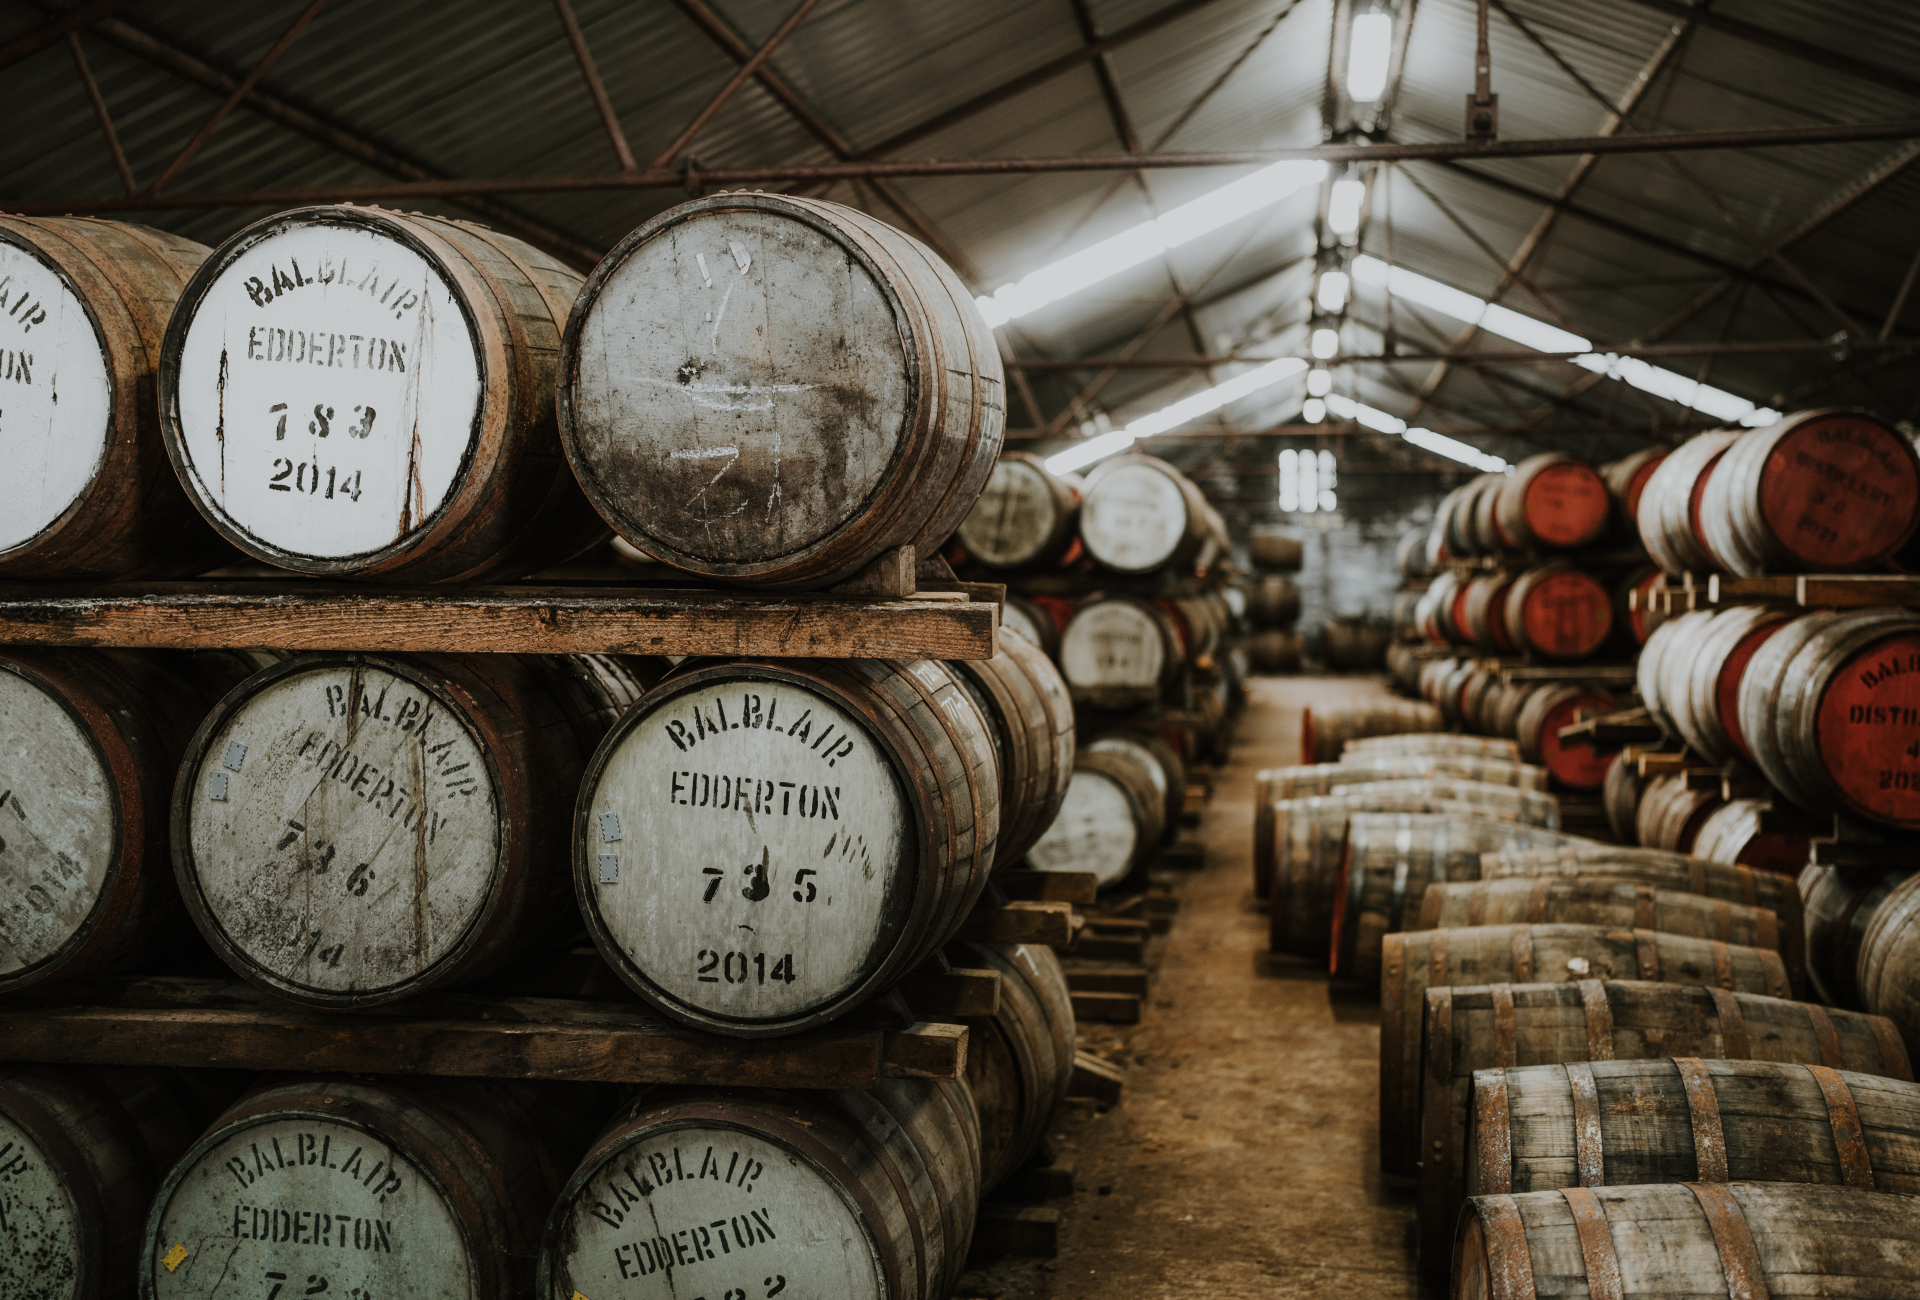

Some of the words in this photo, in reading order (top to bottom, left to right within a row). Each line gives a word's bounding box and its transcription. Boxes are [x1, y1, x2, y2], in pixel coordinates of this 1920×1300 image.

[243, 255, 418, 320] BALBLAIR
[248, 325, 406, 373] EDDERTON
[268, 457, 362, 502] 2014
[326, 684, 478, 799] BALBLAIR
[665, 694, 854, 767] BALBLAIR
[299, 730, 447, 845] EDDERTON
[670, 771, 840, 820] EDDERTON
[6, 851, 83, 942] 014
[697, 949, 796, 986] 2014
[226, 1133, 401, 1203] BALBLAIR
[591, 1145, 763, 1230] BALBLAIR
[233, 1205, 391, 1253] EDDERTON
[614, 1207, 777, 1280] EDDERTON
